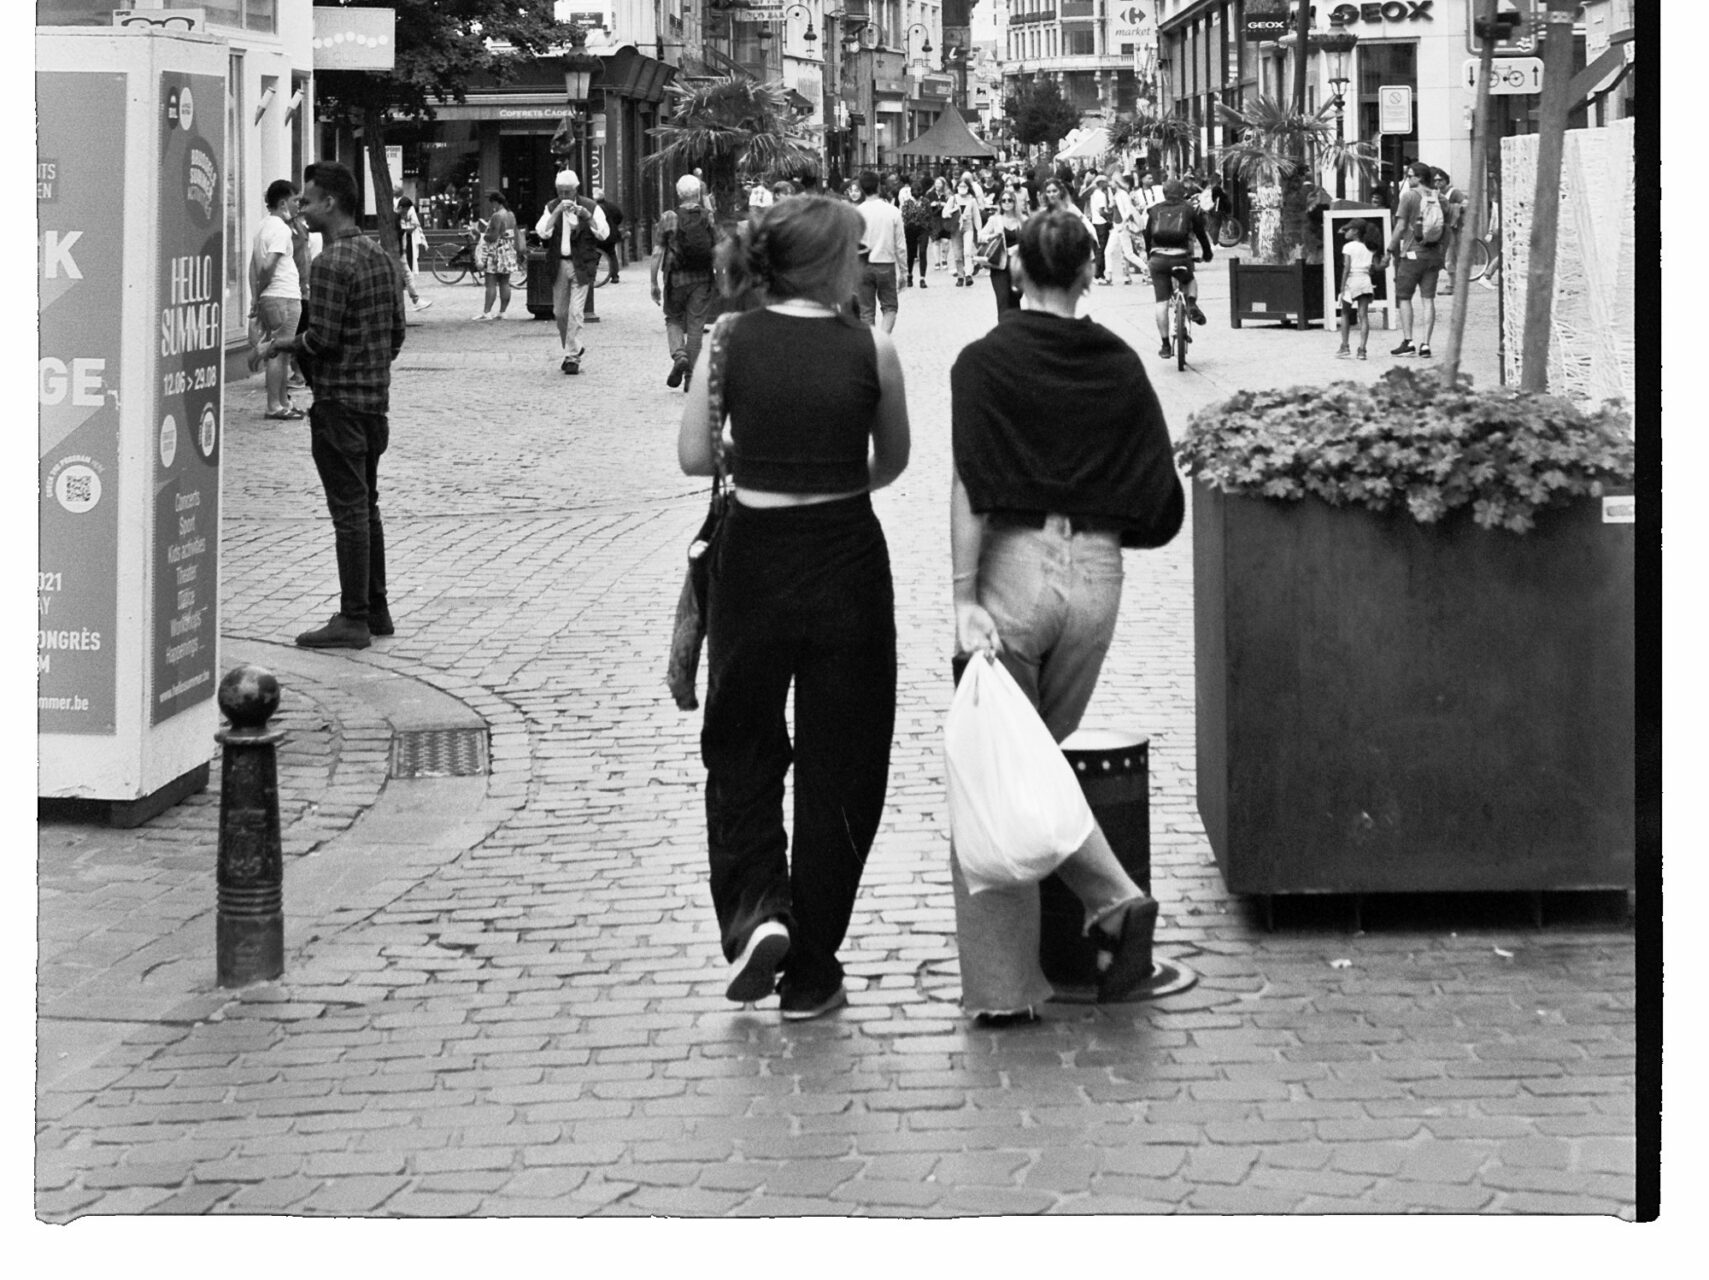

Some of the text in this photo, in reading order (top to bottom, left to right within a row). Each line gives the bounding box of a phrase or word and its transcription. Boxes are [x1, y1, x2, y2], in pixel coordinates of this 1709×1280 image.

[1247, 21, 1284, 30] GEOX
[1333, 0, 1434, 26] GEOX
[1115, 27, 1151, 37] market
[544, 109, 577, 117] CADEA
[45, 230, 84, 280] K
[171, 255, 212, 305] HELLO
[161, 302, 220, 357] SUMMER
[39, 357, 106, 407] GE
[163, 371, 186, 396] 12.06
[194, 365, 217, 390] 29.08
